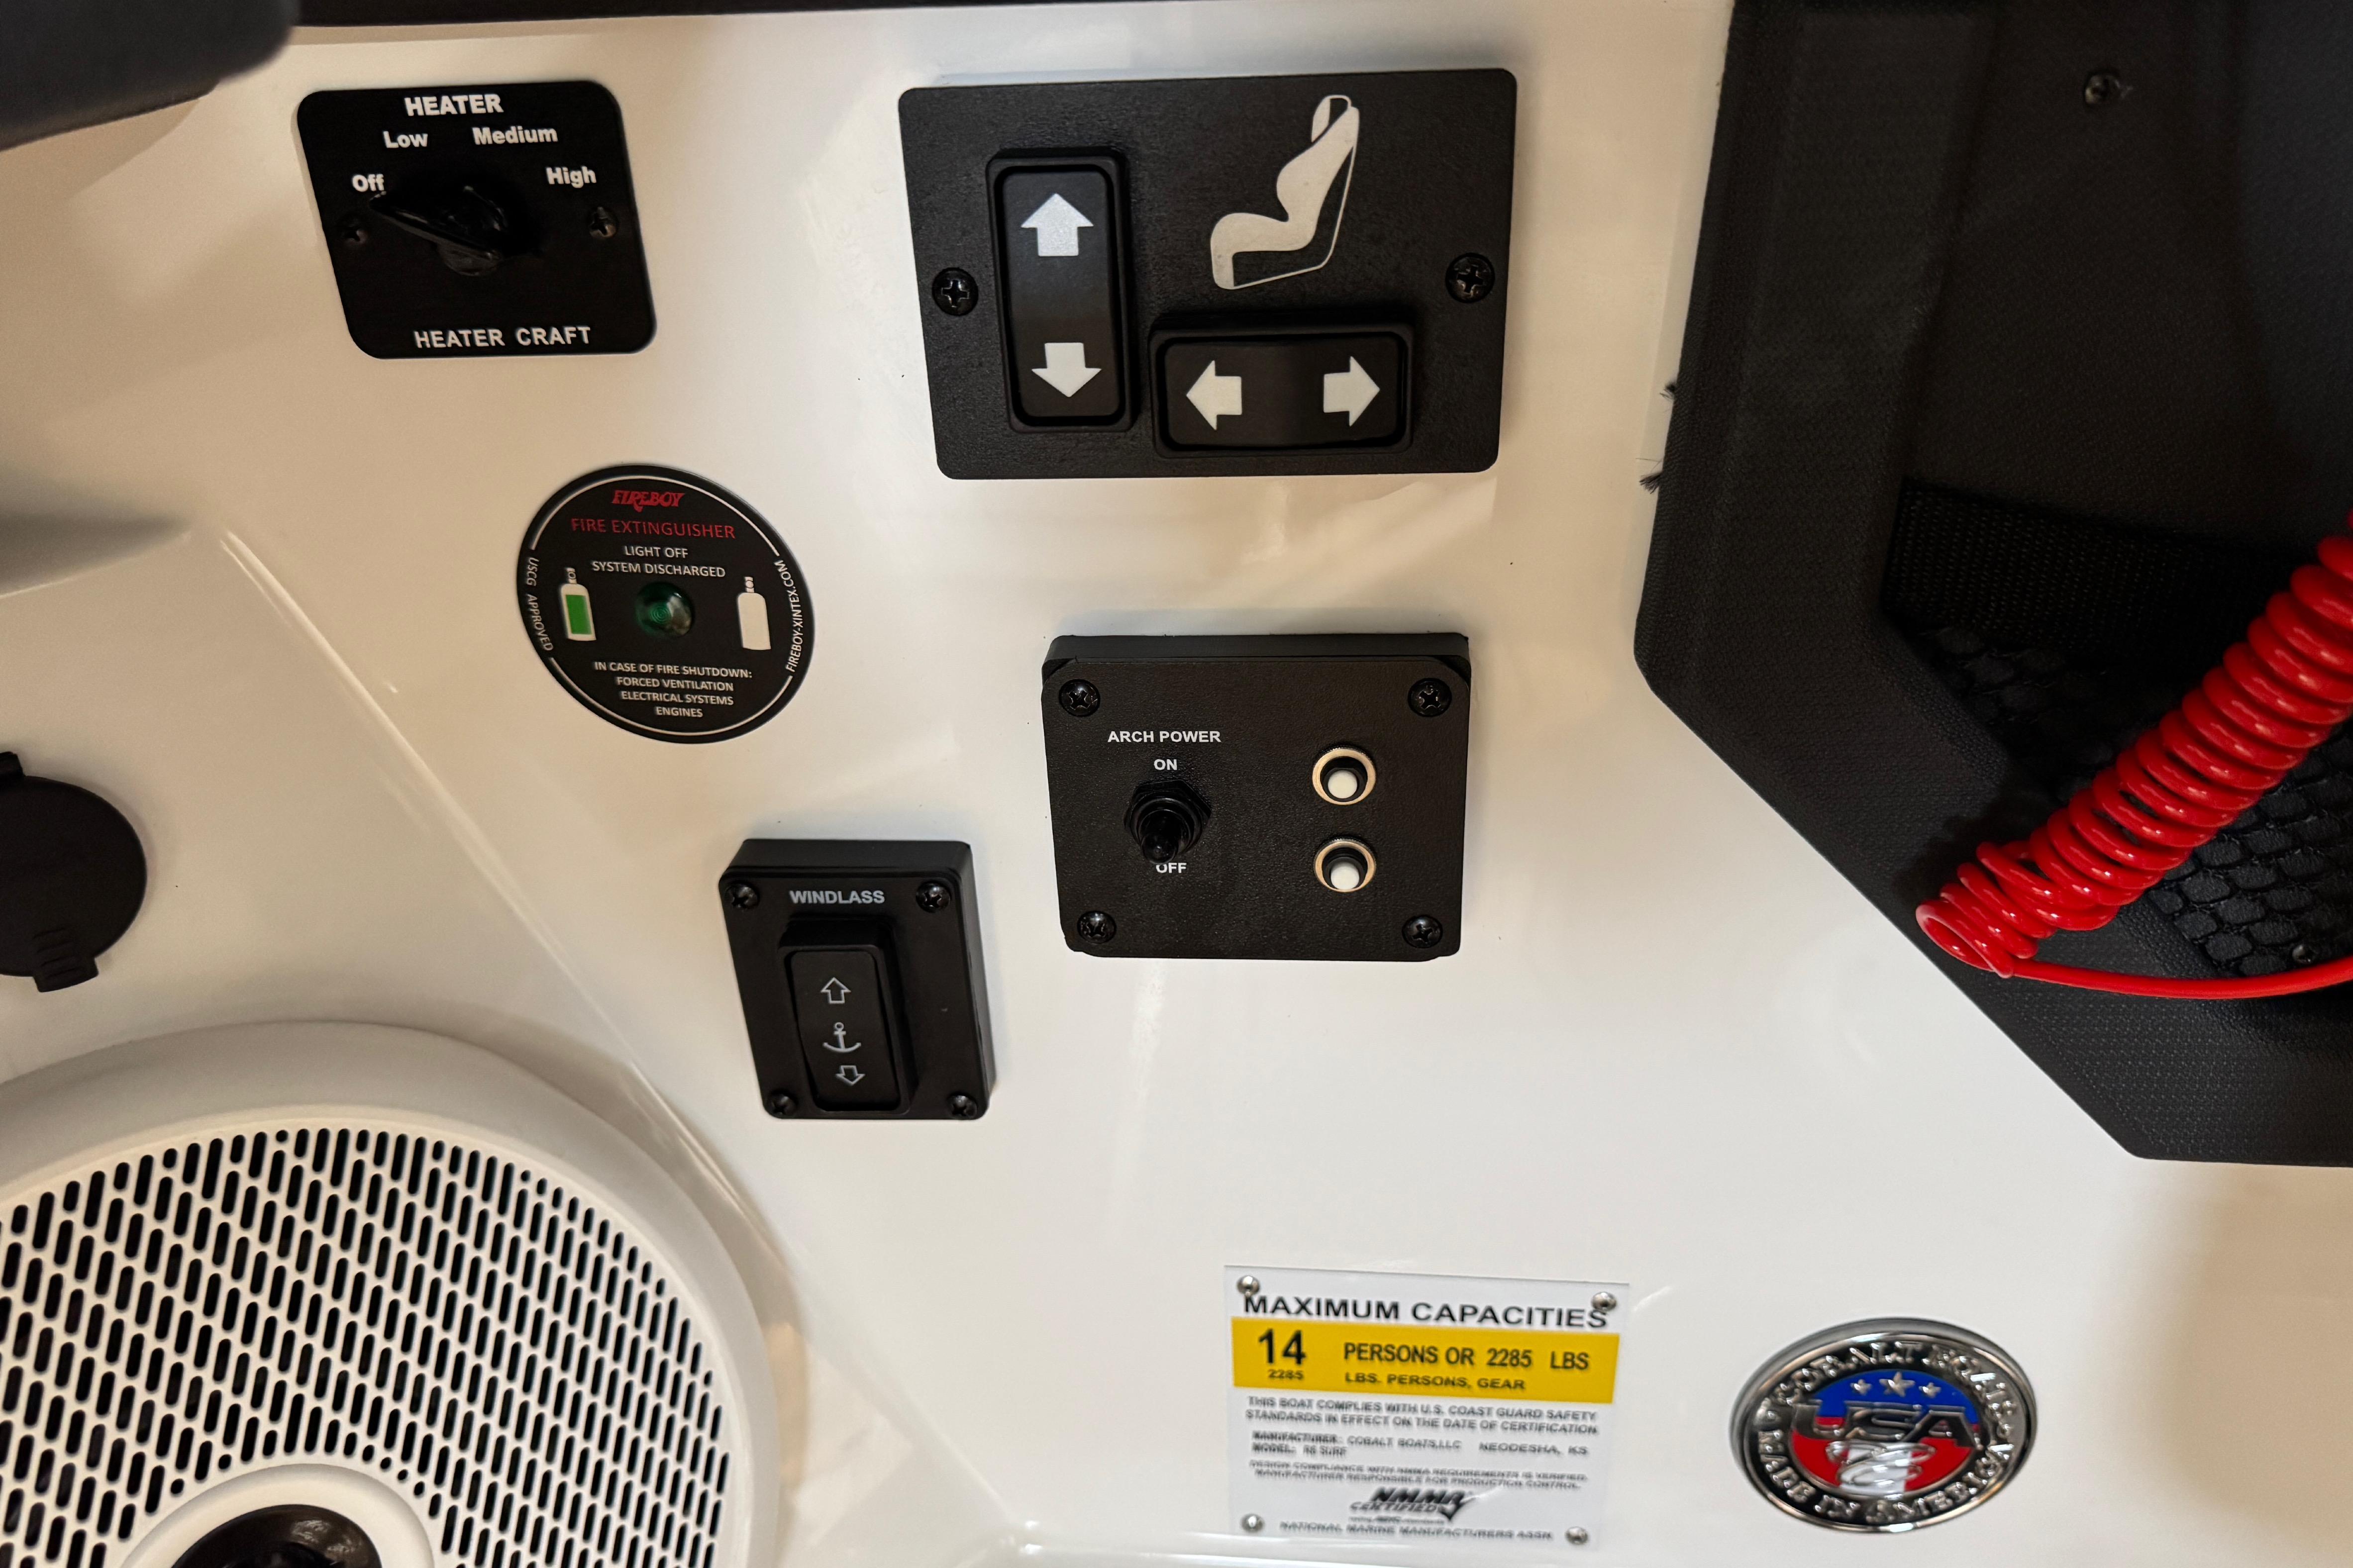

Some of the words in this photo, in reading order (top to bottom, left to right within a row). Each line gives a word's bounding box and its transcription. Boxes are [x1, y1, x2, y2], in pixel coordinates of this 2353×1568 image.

[404, 94, 504, 116] HEATER
[382, 130, 428, 148] Low
[472, 125, 558, 145] Medium
[352, 174, 385, 192] Off
[546, 166, 597, 189] High
[414, 329, 506, 348] HEATER
[515, 326, 591, 345] CRAFT
[612, 490, 685, 512] FIREBOY
[570, 518, 607, 533] FIRE
[611, 520, 736, 539] EXTINGUISHER
[623, 545, 661, 557] LIGHT
[665, 547, 689, 558] OFF
[526, 557, 540, 587] USCG
[591, 560, 641, 573] SYSTEM
[644, 563, 726, 578] DISCHARGED
[526, 593, 554, 651] APPROVED
[774, 560, 804, 673] FIREBOY-XINTEX.COM
[594, 661, 607, 671] IN
[609, 662, 637, 672] CASE
[639, 663, 654, 673] OF
[656, 664, 680, 674] FIRE
[682, 666, 753, 678] SHUTDOWN:
[616, 677, 660, 687] FORCED
[661, 679, 734, 691] VENTILATION
[620, 690, 683, 702] ELECTRICAL
[685, 694, 734, 705] SYSTEMS
[655, 706, 703, 717] ENGINES
[1107, 730, 1155, 743] ARCH
[1159, 730, 1222, 743] POWER
[1153, 759, 1178, 771] ON
[1155, 862, 1187, 874] OFF
[789, 890, 885, 904] WINDLASS
[1243, 1295, 1399, 1319] MAXIMUM
[1412, 1302, 1608, 1328] CAPACITIES
[1258, 1328, 1307, 1365] 14
[1344, 1342, 1438, 1365] PERSONS
[1445, 1346, 1475, 1366] OR
[1487, 1347, 1532, 1368] 2285
[1549, 1350, 1590, 1371] LBS
[1268, 1369, 1304, 1380] 2285
[1387, 1374, 1471, 1388] PERSONS,
[1477, 1377, 1526, 1389] GEAR
[1248, 1395, 1276, 1407] THIS
[1278, 1397, 1314, 1409] BOAT
[1316, 1399, 1382, 1412] COMPLIES
[1384, 1402, 1419, 1413] WITH
[1420, 1404, 1444, 1415] U.S.
[1448, 1405, 1493, 1417] COAST
[1496, 1407, 1543, 1419] GUARD
[1546, 1409, 1597, 1421] SAFETY
[1245, 1409, 1323, 1423] STANDARDS
[1325, 1412, 1338, 1423] IN
[1340, 1414, 1390, 1426] EFFECT
[1392, 1416, 1412, 1426] ON
[1416, 1418, 1439, 1428] THE
[1442, 1418, 1477, 1430] DATE
[1479, 1420, 1498, 1431] OF
[1791, 1399, 1983, 1451] USA
[1346, 1435, 1394, 1447] COBALT
[1479, 1442, 1561, 1456] NEODESHA,
[1567, 1445, 1589, 1456] KS
[1349, 1501, 1437, 1513] CERTIFIED
[1279, 1521, 1343, 1532] NATIONAL
